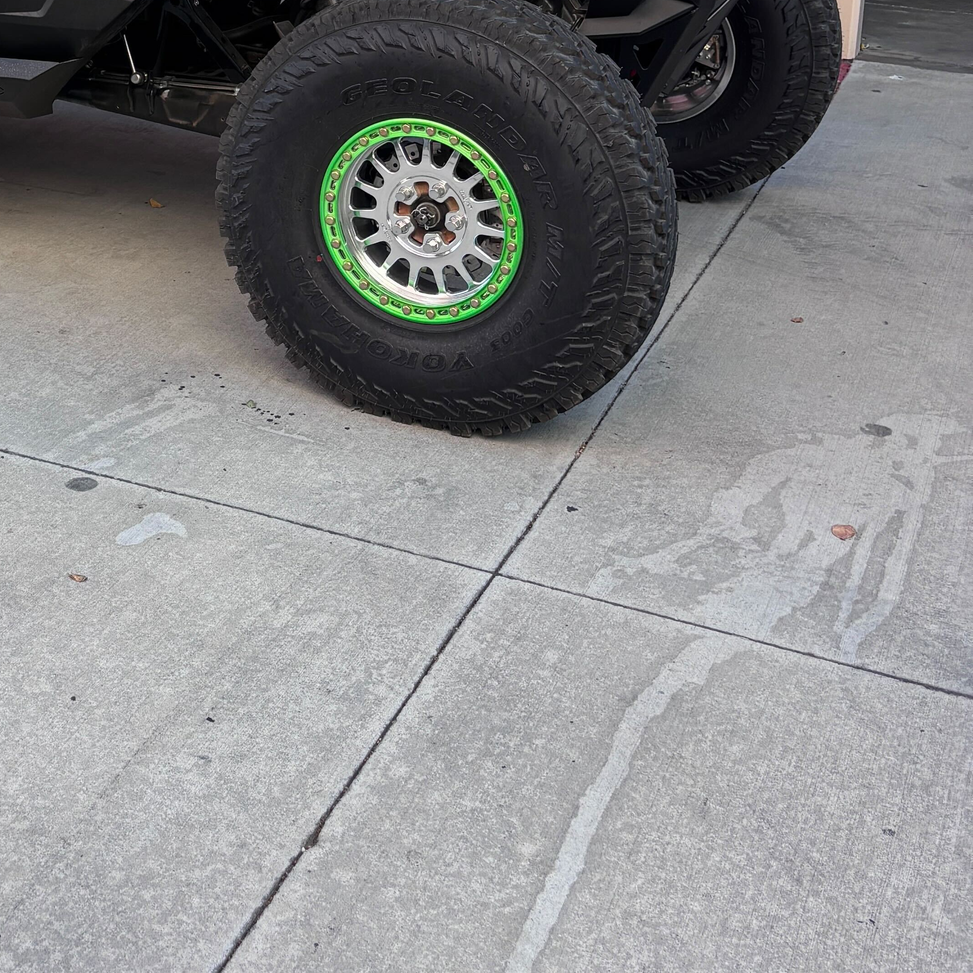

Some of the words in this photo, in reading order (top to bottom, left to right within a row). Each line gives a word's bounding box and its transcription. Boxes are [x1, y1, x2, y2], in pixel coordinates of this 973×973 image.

[340, 75, 559, 211] GEOLANDAR
[287, 255, 476, 373] YOKOHAMA
[538, 221, 566, 309] M/T
[489, 307, 535, 353] G003
